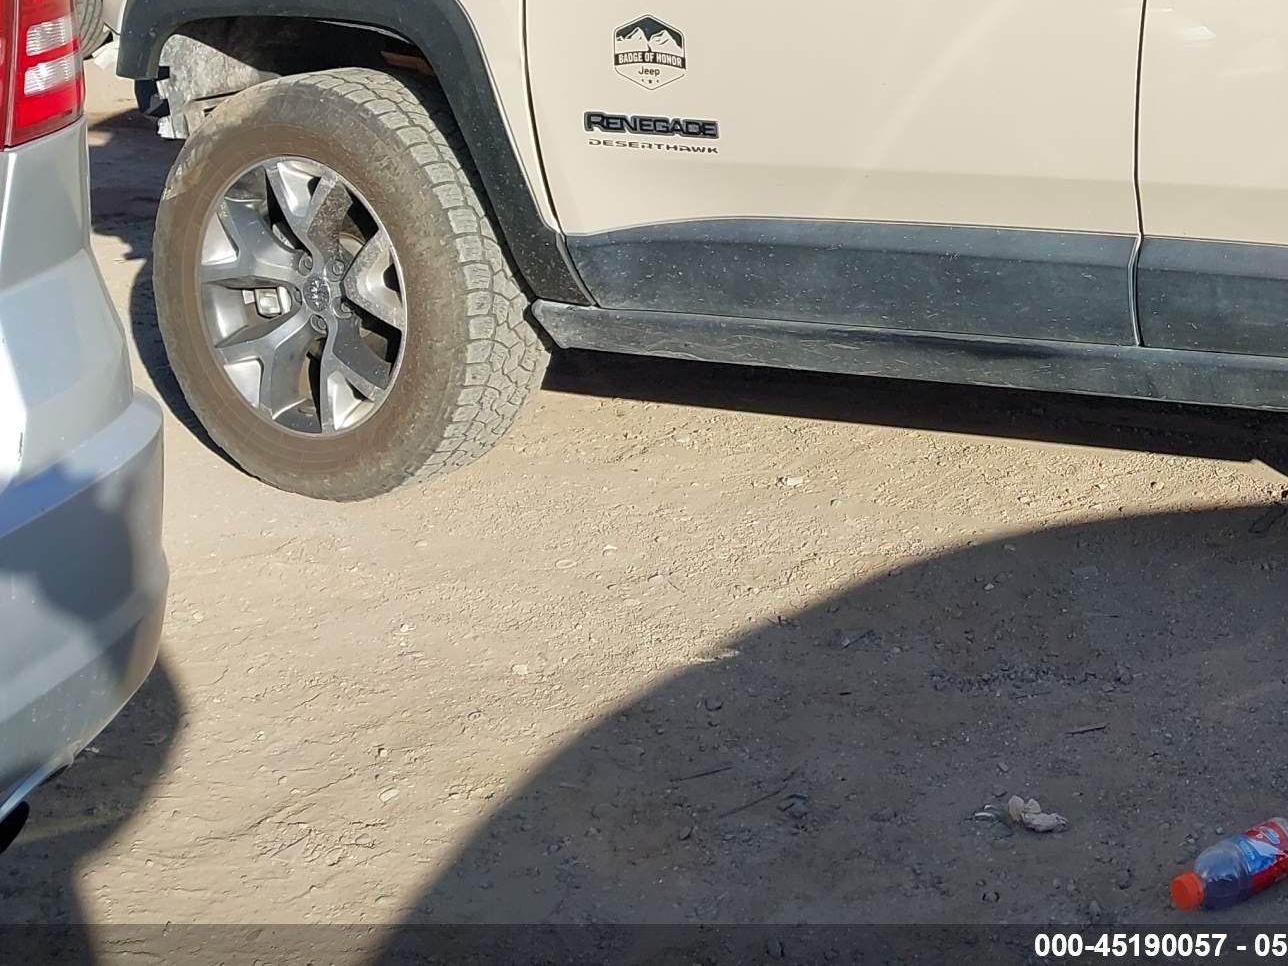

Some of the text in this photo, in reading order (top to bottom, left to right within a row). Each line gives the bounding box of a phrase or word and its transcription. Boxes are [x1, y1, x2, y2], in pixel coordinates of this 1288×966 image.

[618, 52, 683, 68] BADGE OF HONOR
[638, 66, 661, 77] Jeep
[584, 111, 719, 139] RENEGADE
